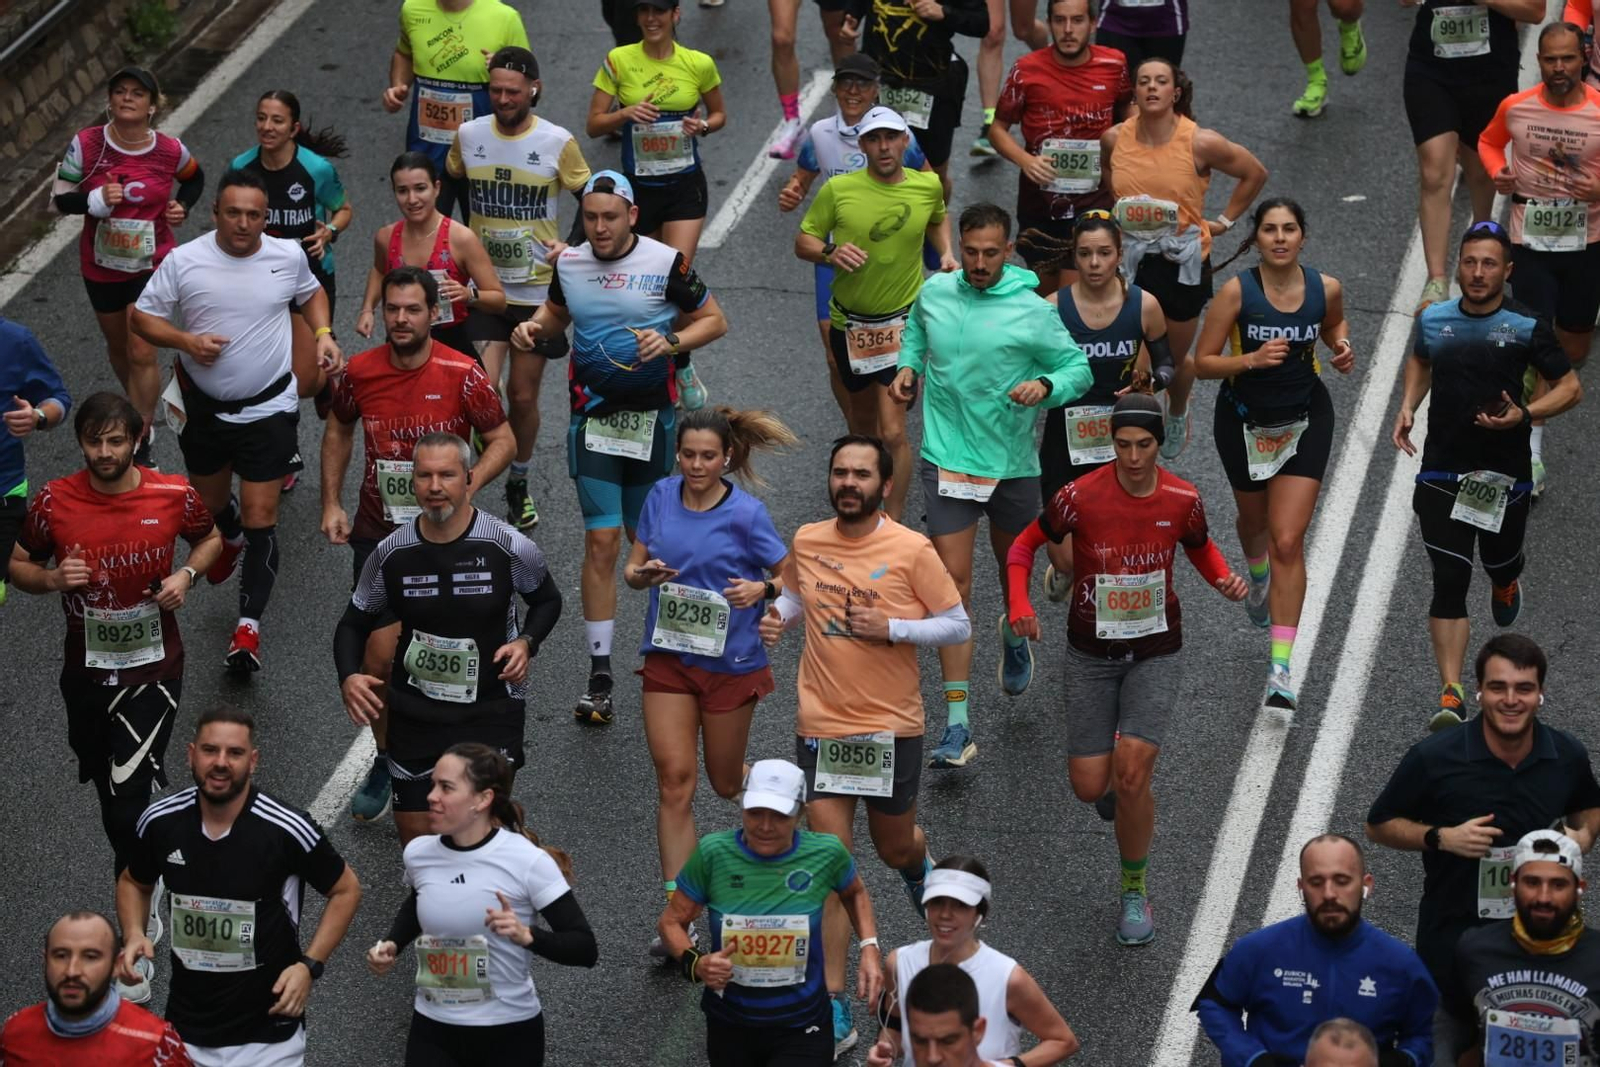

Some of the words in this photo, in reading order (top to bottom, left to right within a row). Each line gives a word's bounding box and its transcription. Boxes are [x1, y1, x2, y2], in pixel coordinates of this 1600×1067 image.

[1440, 18, 1474, 36] 9911
[435, 48, 470, 73] ATLETISMO
[886, 89, 921, 105] 9552
[425, 102, 458, 122] 5251
[641, 134, 679, 154] 8697
[494, 167, 512, 181] 59
[282, 207, 314, 226] TRAIL
[484, 203, 548, 222] SEBASTIAN
[1533, 210, 1573, 228] 9912
[103, 230, 141, 251] 7064
[487, 240, 523, 260] 8896
[857, 329, 895, 349] 5364
[1459, 477, 1497, 503] 9909
[1107, 589, 1152, 611] 6828
[667, 600, 712, 625] 9238
[97, 622, 144, 643] 8923
[415, 649, 461, 674] 8536
[829, 743, 876, 766] 9856
[184, 914, 233, 941] 8010
[729, 934, 795, 956] 13927
[426, 952, 468, 977] 8011
[1487, 972, 1505, 990] ME
[1506, 970, 1532, 985] HAN
[1532, 970, 1588, 999] LLAMADO
[1495, 987, 1534, 1004] MUCHAS
[1535, 989, 1563, 1008] COSAS
[1498, 1033, 1556, 1064] 2813
